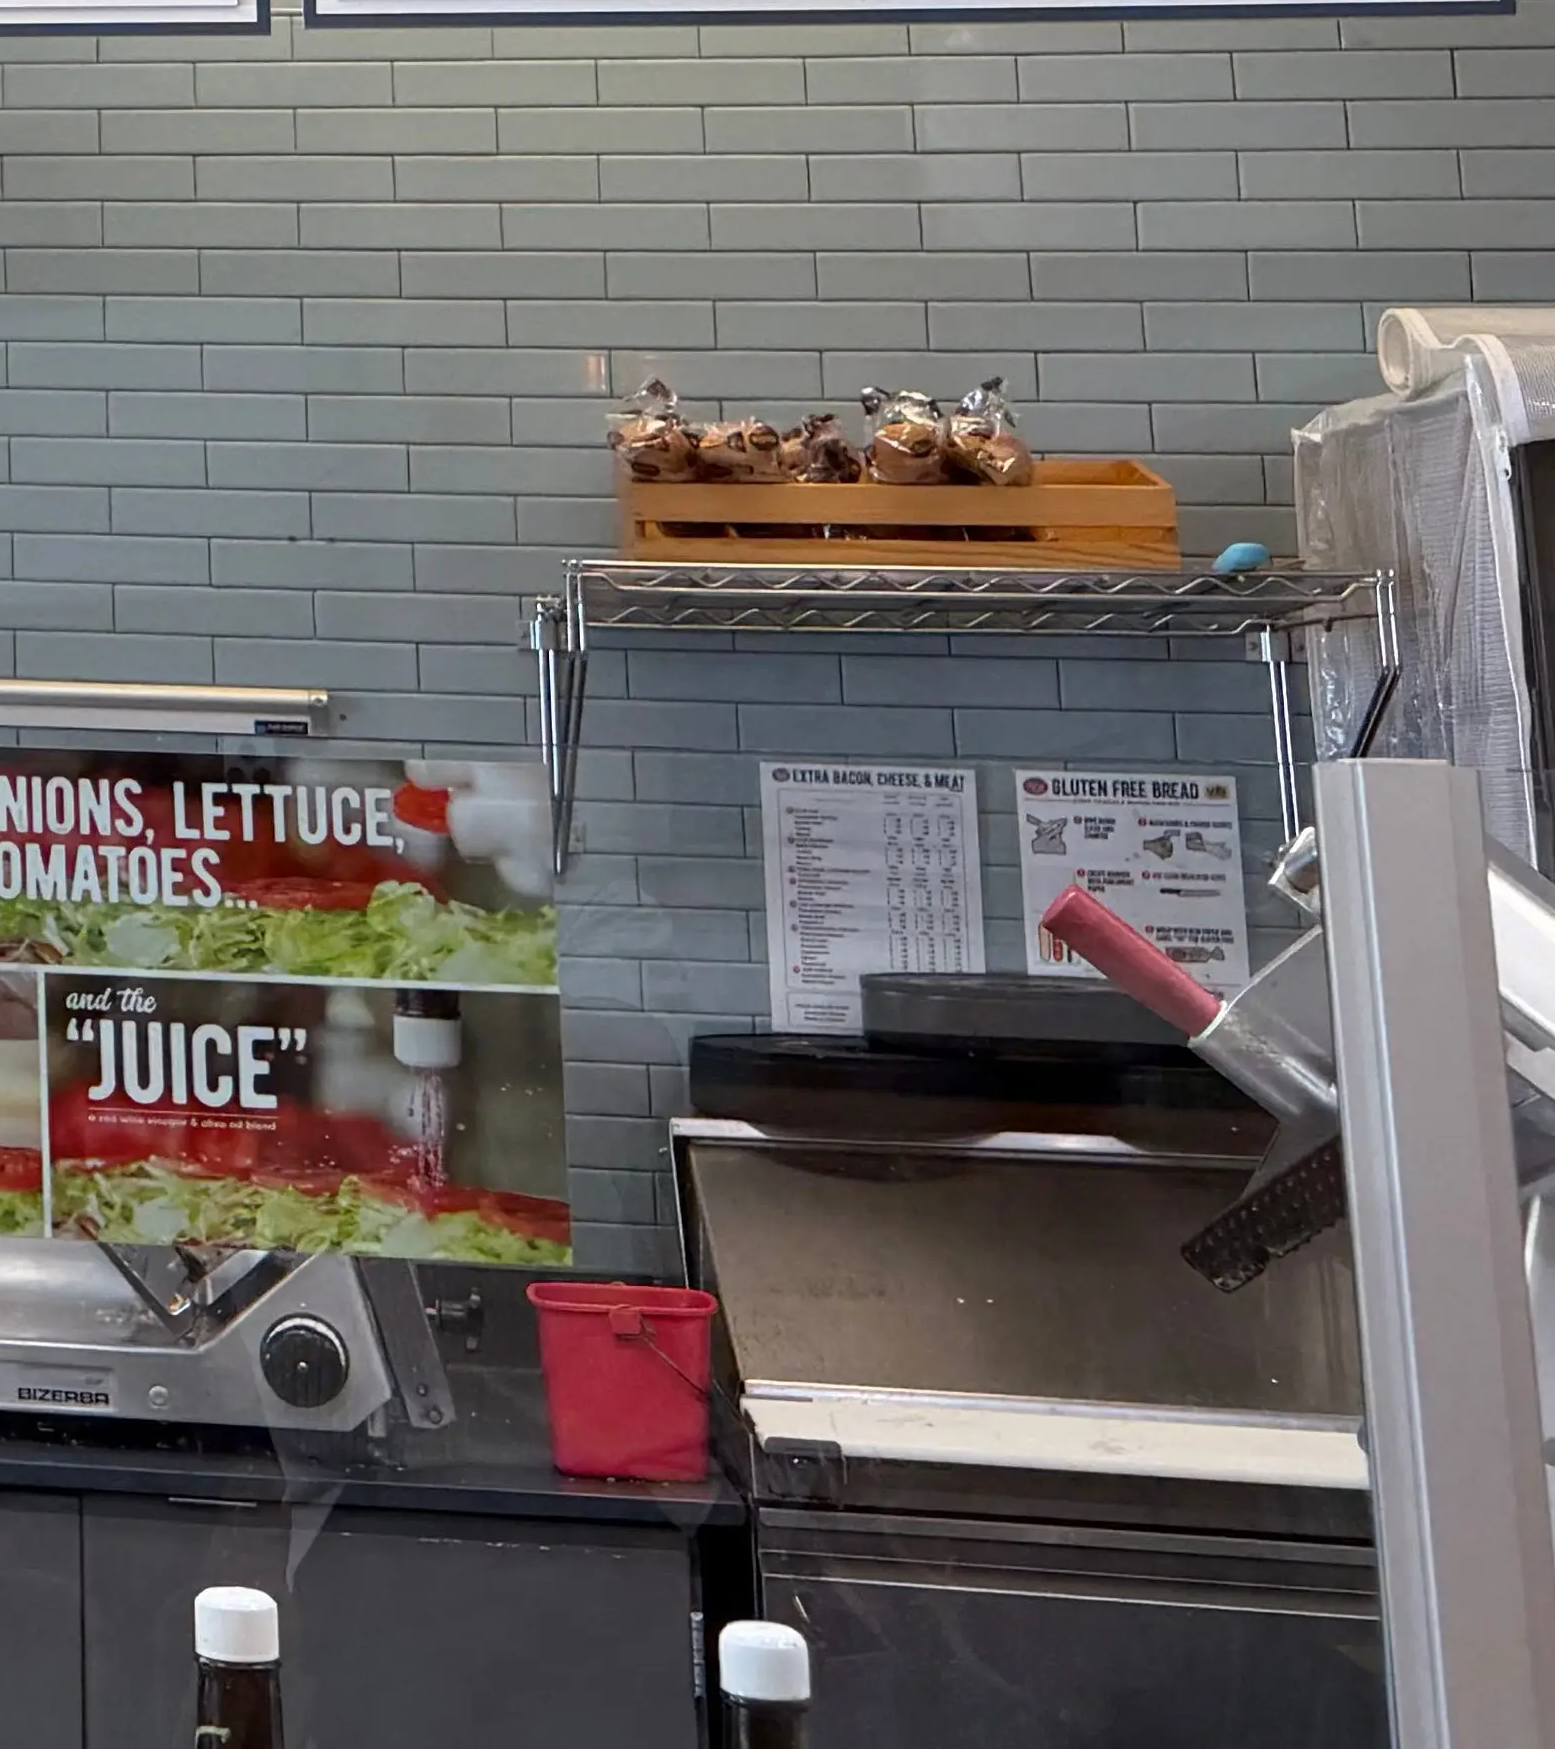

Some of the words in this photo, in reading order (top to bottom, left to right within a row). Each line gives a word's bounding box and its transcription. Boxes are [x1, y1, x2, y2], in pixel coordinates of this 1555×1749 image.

[793, 770, 829, 783] EXTRA
[833, 771, 873, 785] BACON,
[877, 773, 921, 787] CHEESE,
[924, 774, 931, 787] &
[935, 774, 964, 792] MEAT
[1052, 779, 1107, 796] GLUTEN
[1113, 781, 1147, 797] FREE
[1152, 781, 1199, 799] BREAD
[173, 780, 405, 852] LETTUCE,
[66, 988, 111, 1011] and
[117, 988, 156, 1013] the
[18, 1388, 109, 1405] BIZERBA
